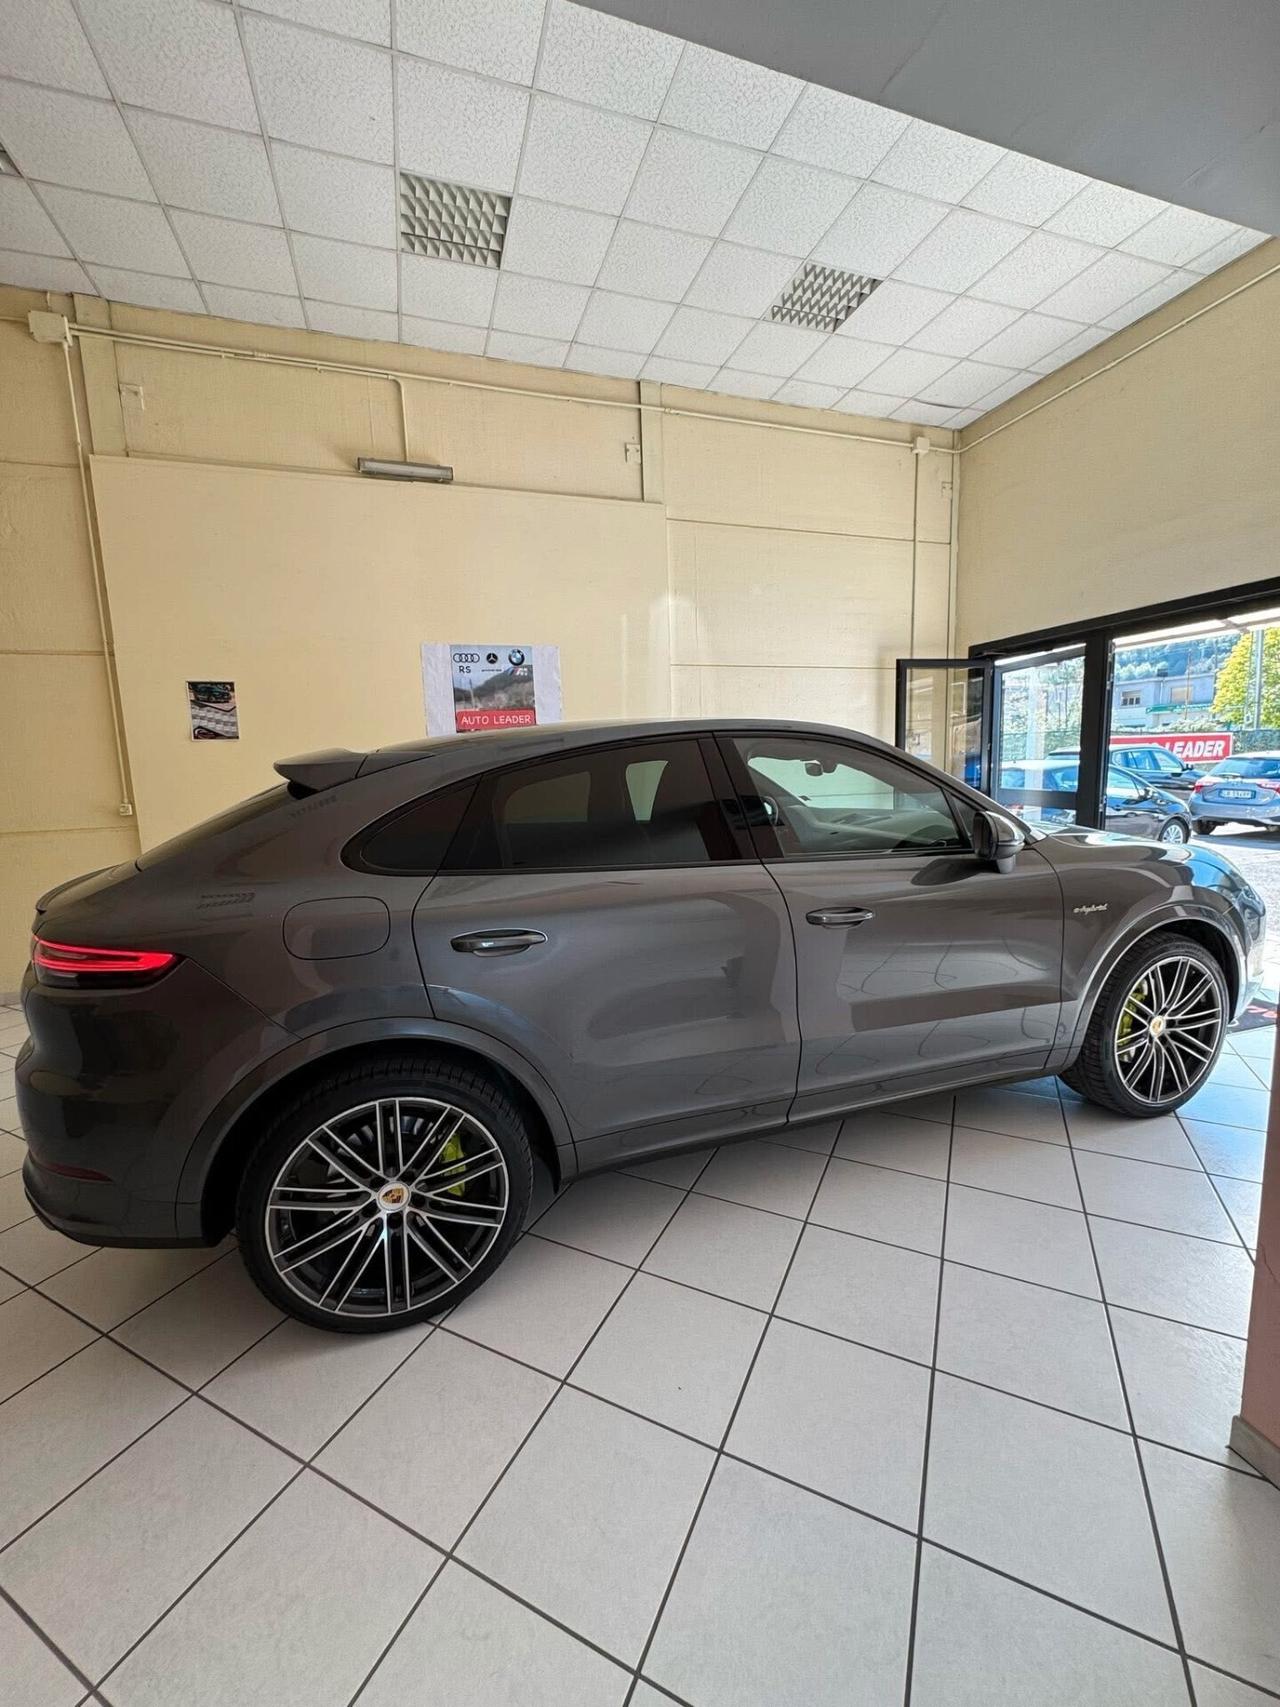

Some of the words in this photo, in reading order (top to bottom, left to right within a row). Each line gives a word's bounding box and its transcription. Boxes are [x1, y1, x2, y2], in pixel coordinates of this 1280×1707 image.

[458, 665, 472, 674] RS
[461, 715, 490, 725] AUTO
[493, 714, 532, 725] LEADER
